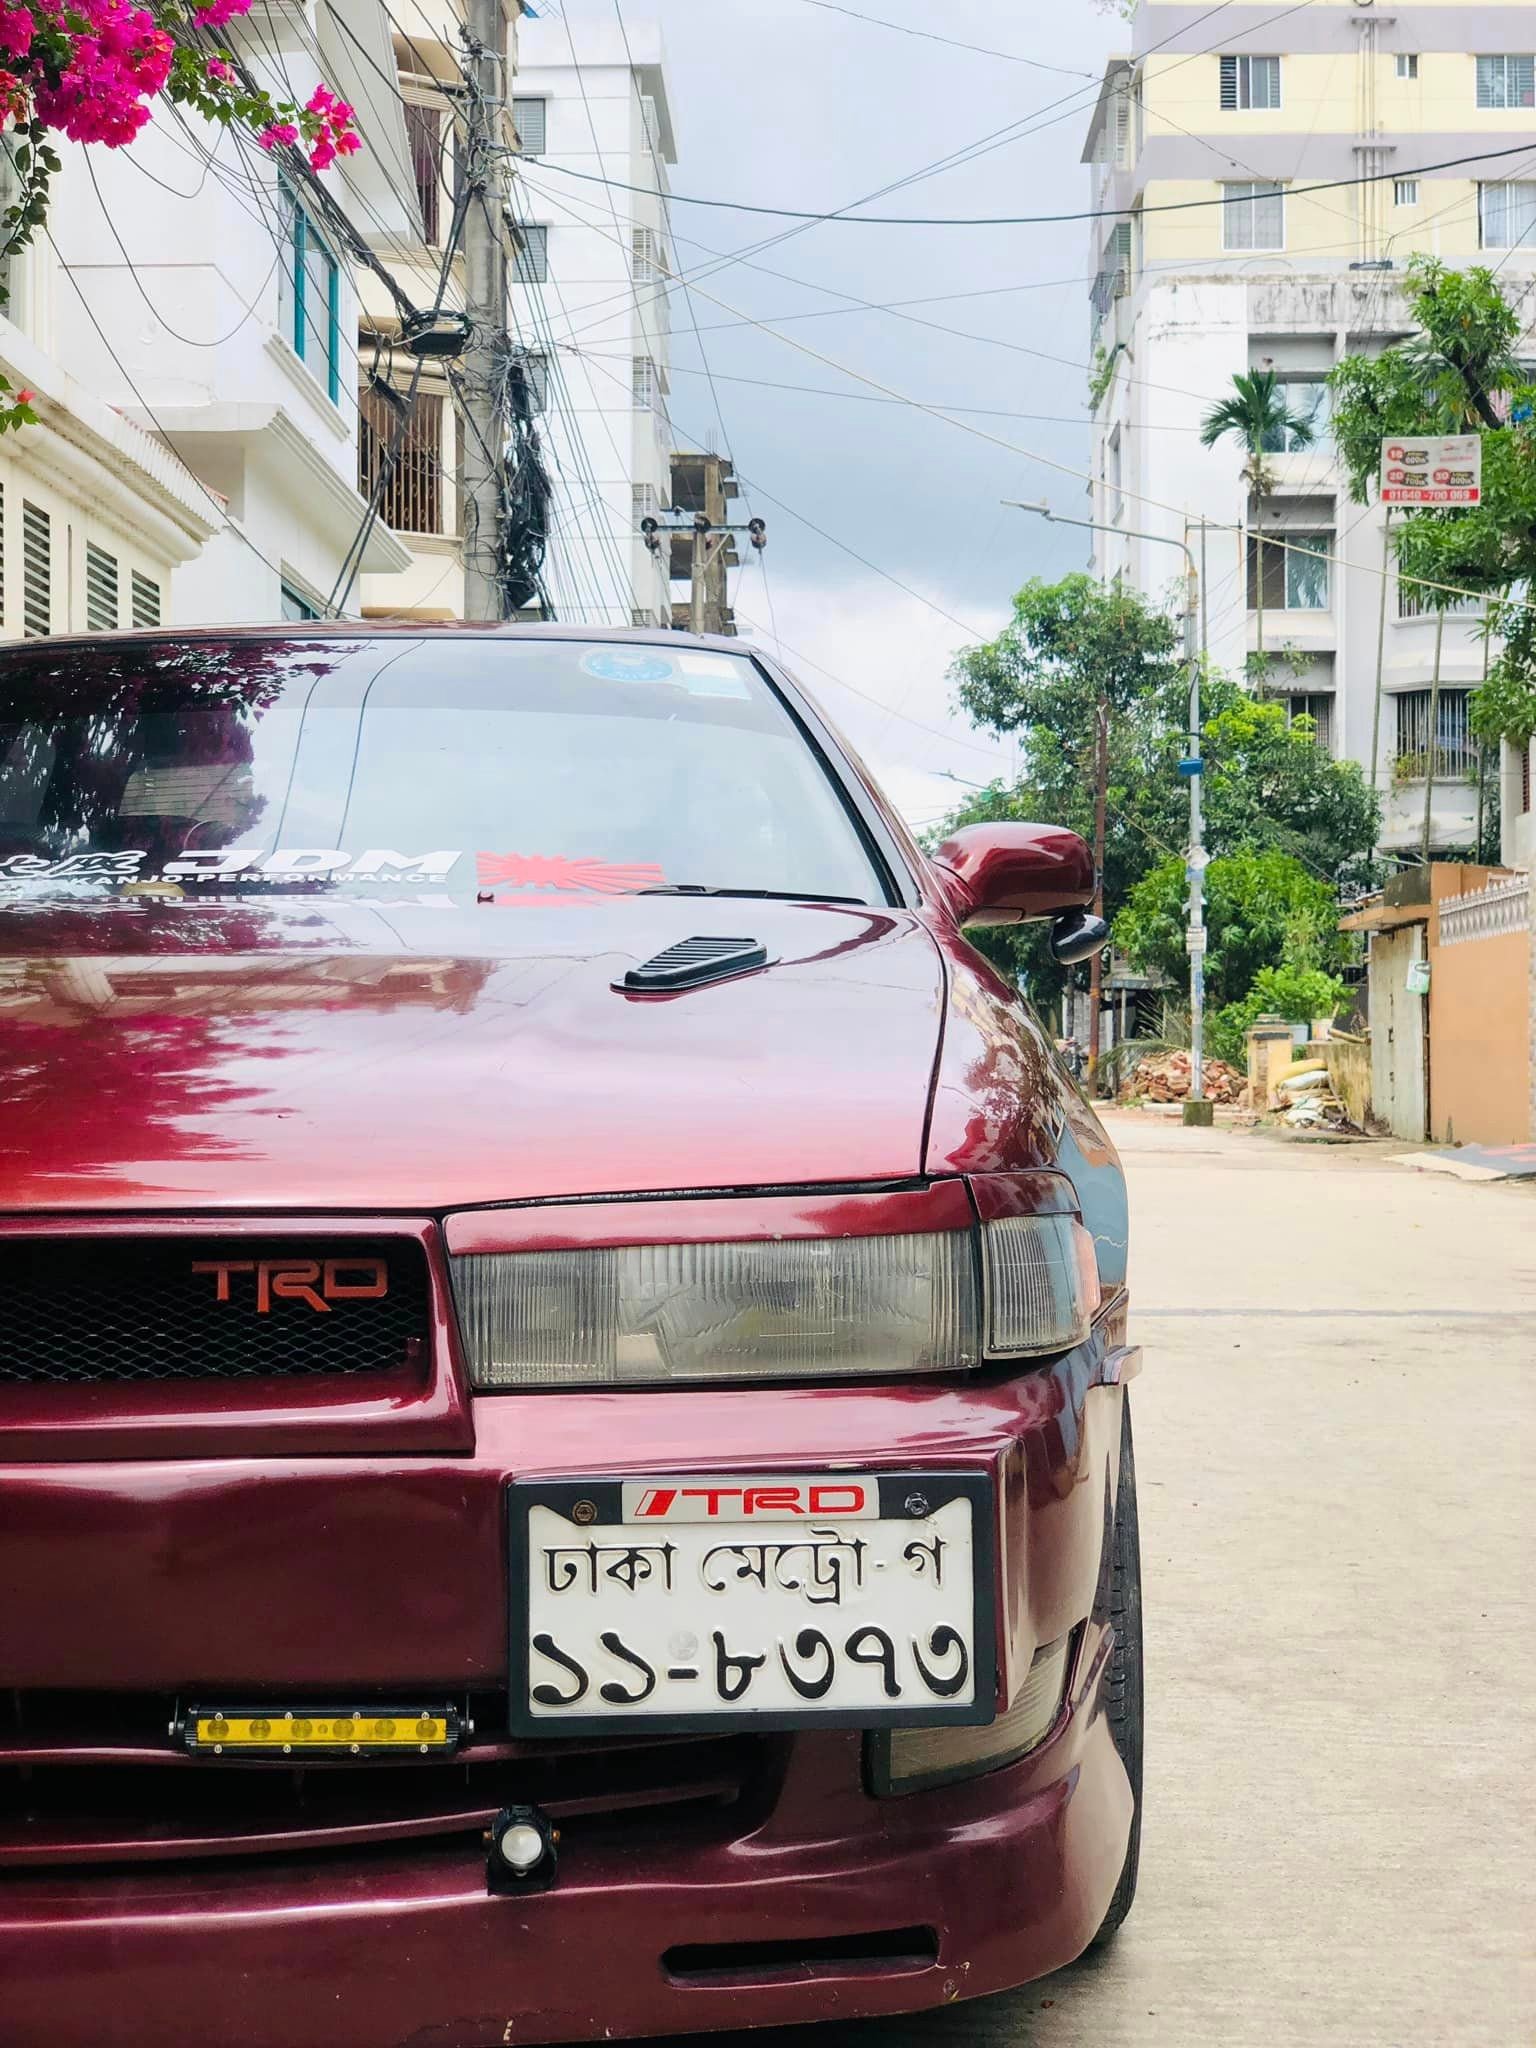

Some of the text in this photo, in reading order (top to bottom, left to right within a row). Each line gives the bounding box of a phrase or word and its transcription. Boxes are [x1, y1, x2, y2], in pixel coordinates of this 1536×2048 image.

[162, 849, 463, 874] JDM
[191, 1259, 389, 1313] TRD
[681, 1486, 865, 1516] TRD
[542, 1541, 678, 1593] ঢাকা
